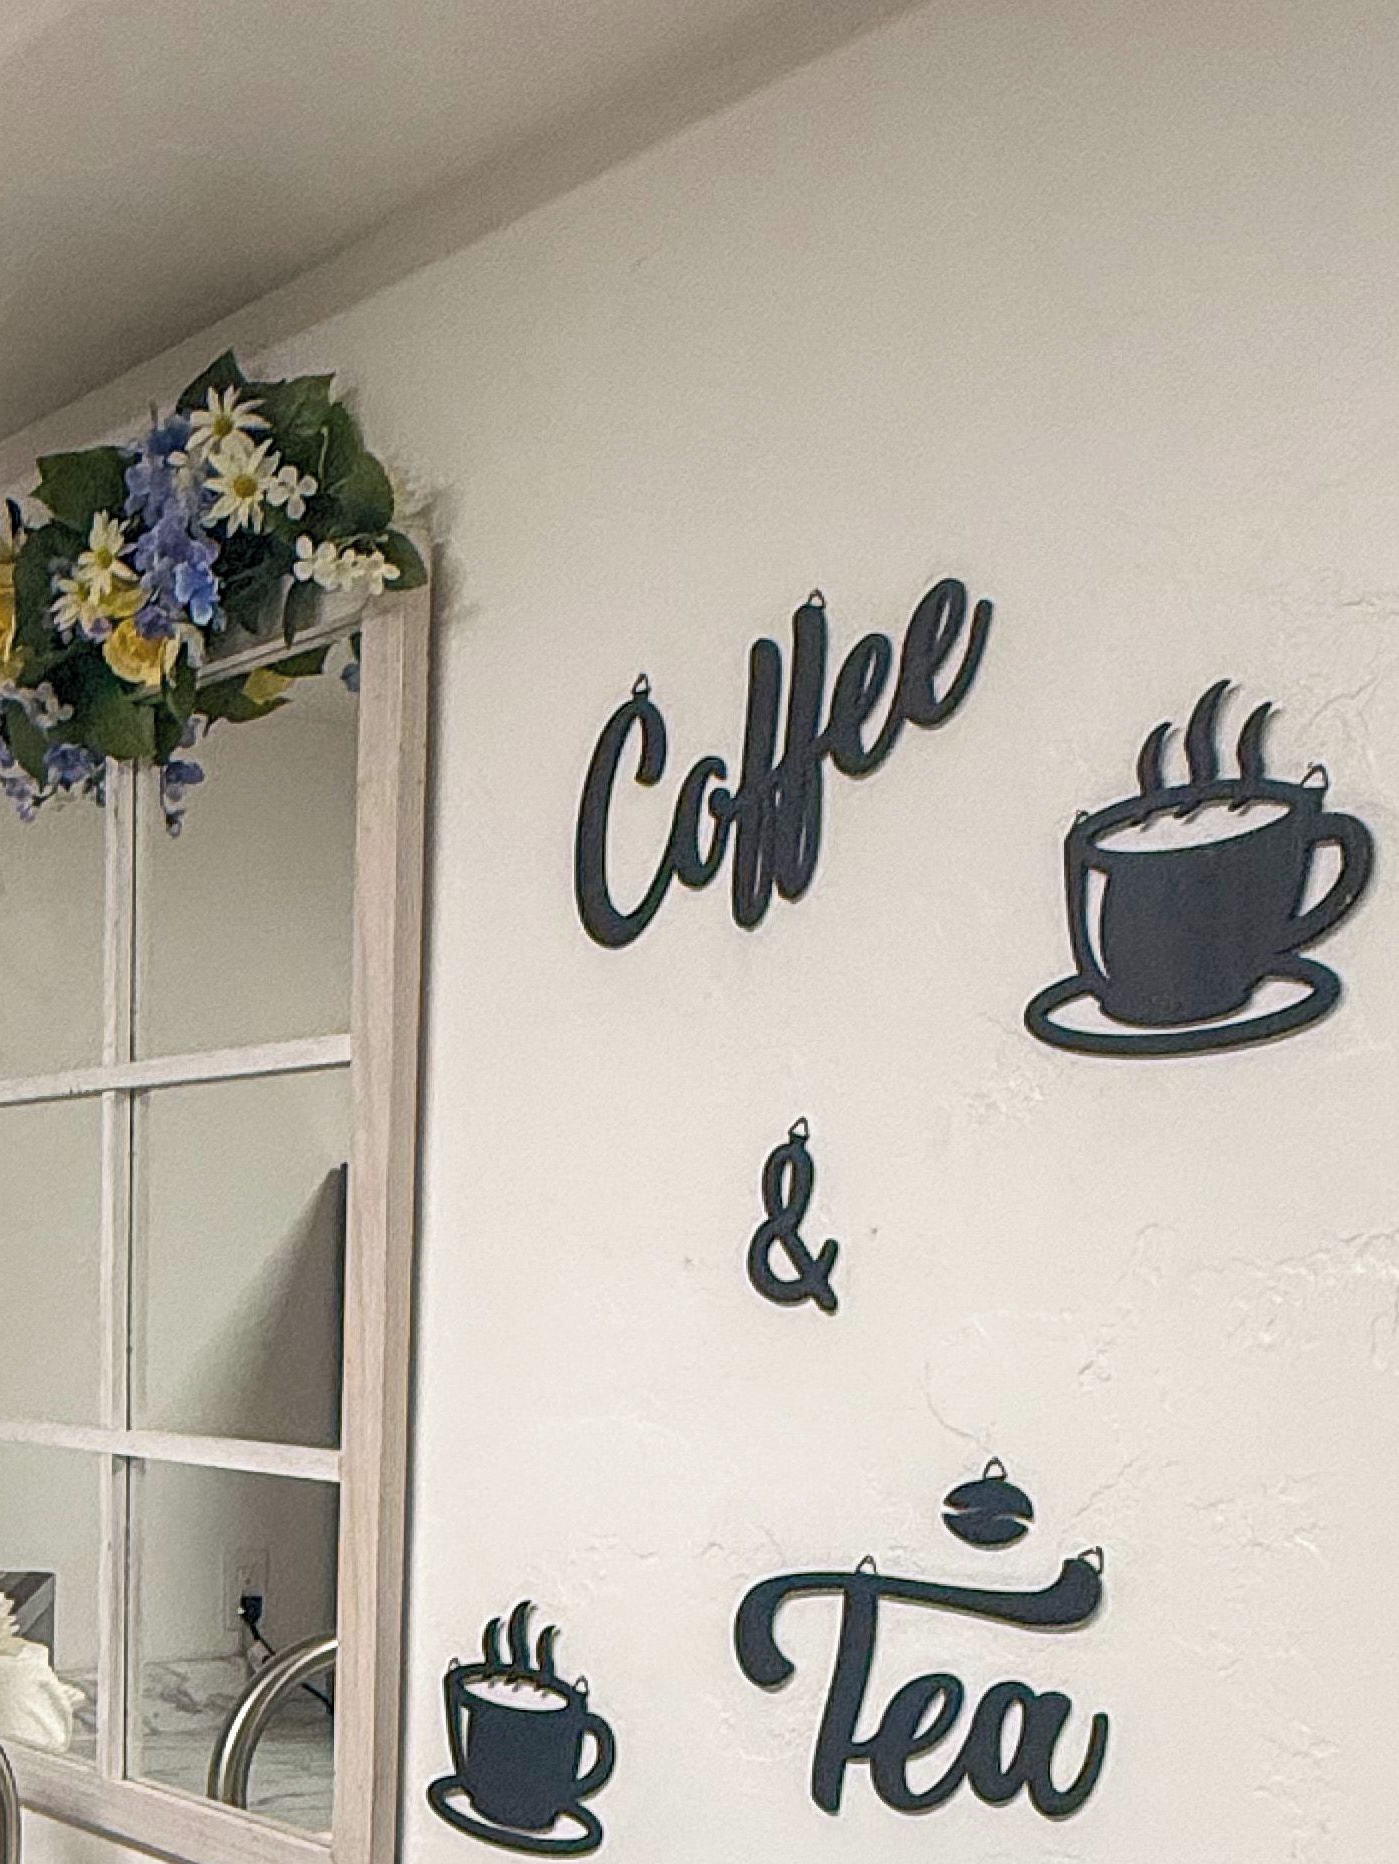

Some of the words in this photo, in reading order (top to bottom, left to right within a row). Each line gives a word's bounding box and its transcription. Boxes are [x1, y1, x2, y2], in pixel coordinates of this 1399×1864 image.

[576, 578, 992, 948] Coffee
[748, 1134, 838, 1314] &
[734, 1554, 1109, 1822] Tea
